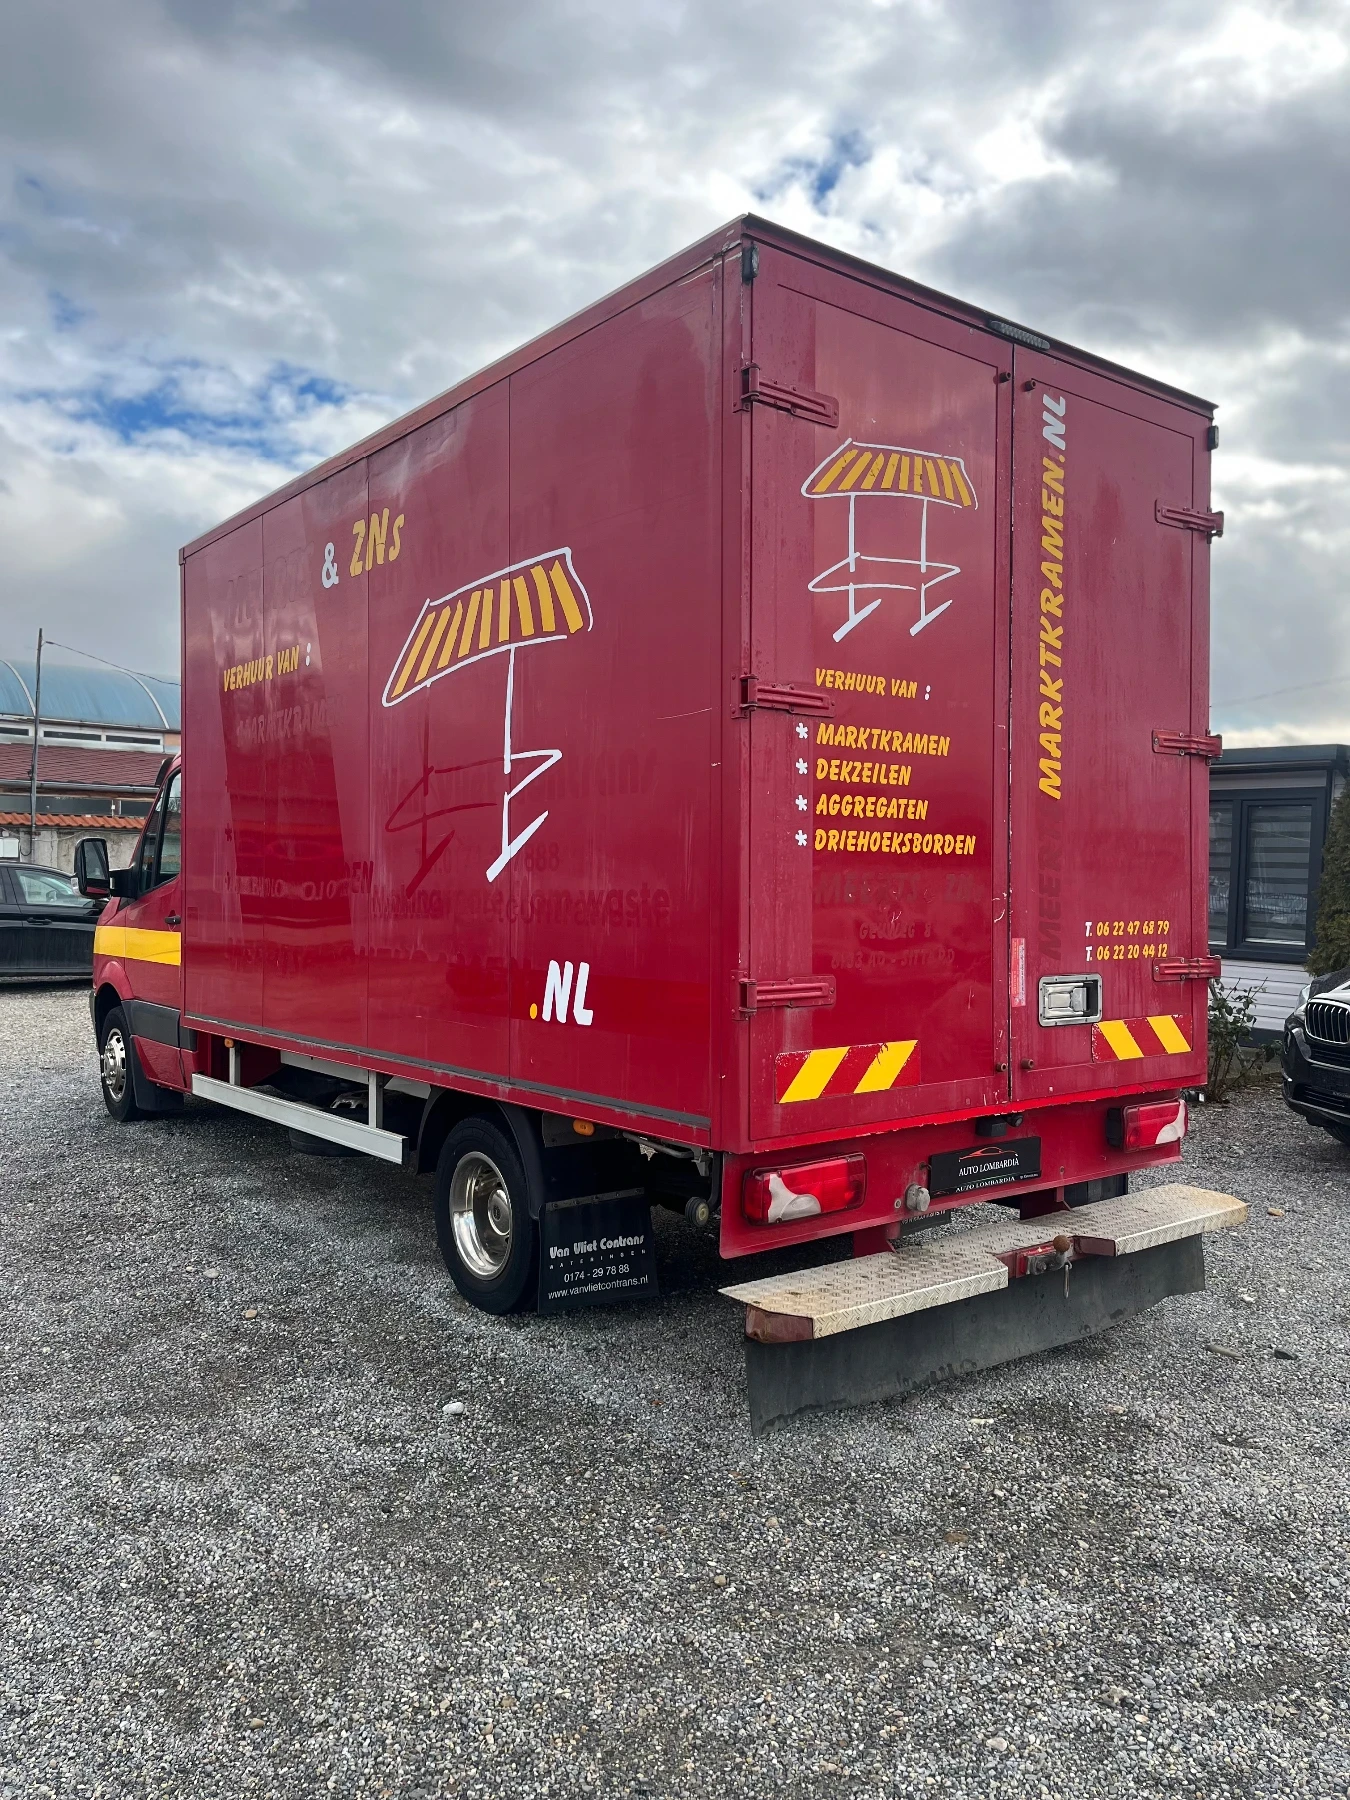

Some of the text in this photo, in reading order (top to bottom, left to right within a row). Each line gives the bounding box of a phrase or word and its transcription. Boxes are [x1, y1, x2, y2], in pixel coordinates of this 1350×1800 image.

[322, 542, 339, 589] &
[1038, 394, 1067, 801] MARKTKRAMEN.NL
[223, 655, 274, 692] VERHUUR
[277, 645, 300, 675] VAN
[815, 668, 886, 696] VERHUUR
[891, 678, 918, 698] VAN
[816, 722, 950, 757] MARKTKRAMEN
[815, 758, 911, 786] DEKZEILEN
[815, 793, 928, 820] AGGREGATEN
[814, 828, 976, 856] DRIEHOEKSBORDEN
[1085, 920, 1169, 937] T. 06 22 47 68 79
[1085, 943, 1168, 962] T. 06 22 20 44 12
[530, 959, 594, 1026] .NL
[958, 1165, 979, 1177] AUTO
[956, 1183, 975, 1192] AUTO
[549, 1234, 645, 1259] Van Vliet Contrans
[564, 1270, 585, 1283] 0174
[592, 1267, 604, 1278] 29
[606, 1265, 617, 1276] 78
[618, 1263, 630, 1274] 88
[548, 1274, 649, 1300] www.vanvlietcontrans.nl
